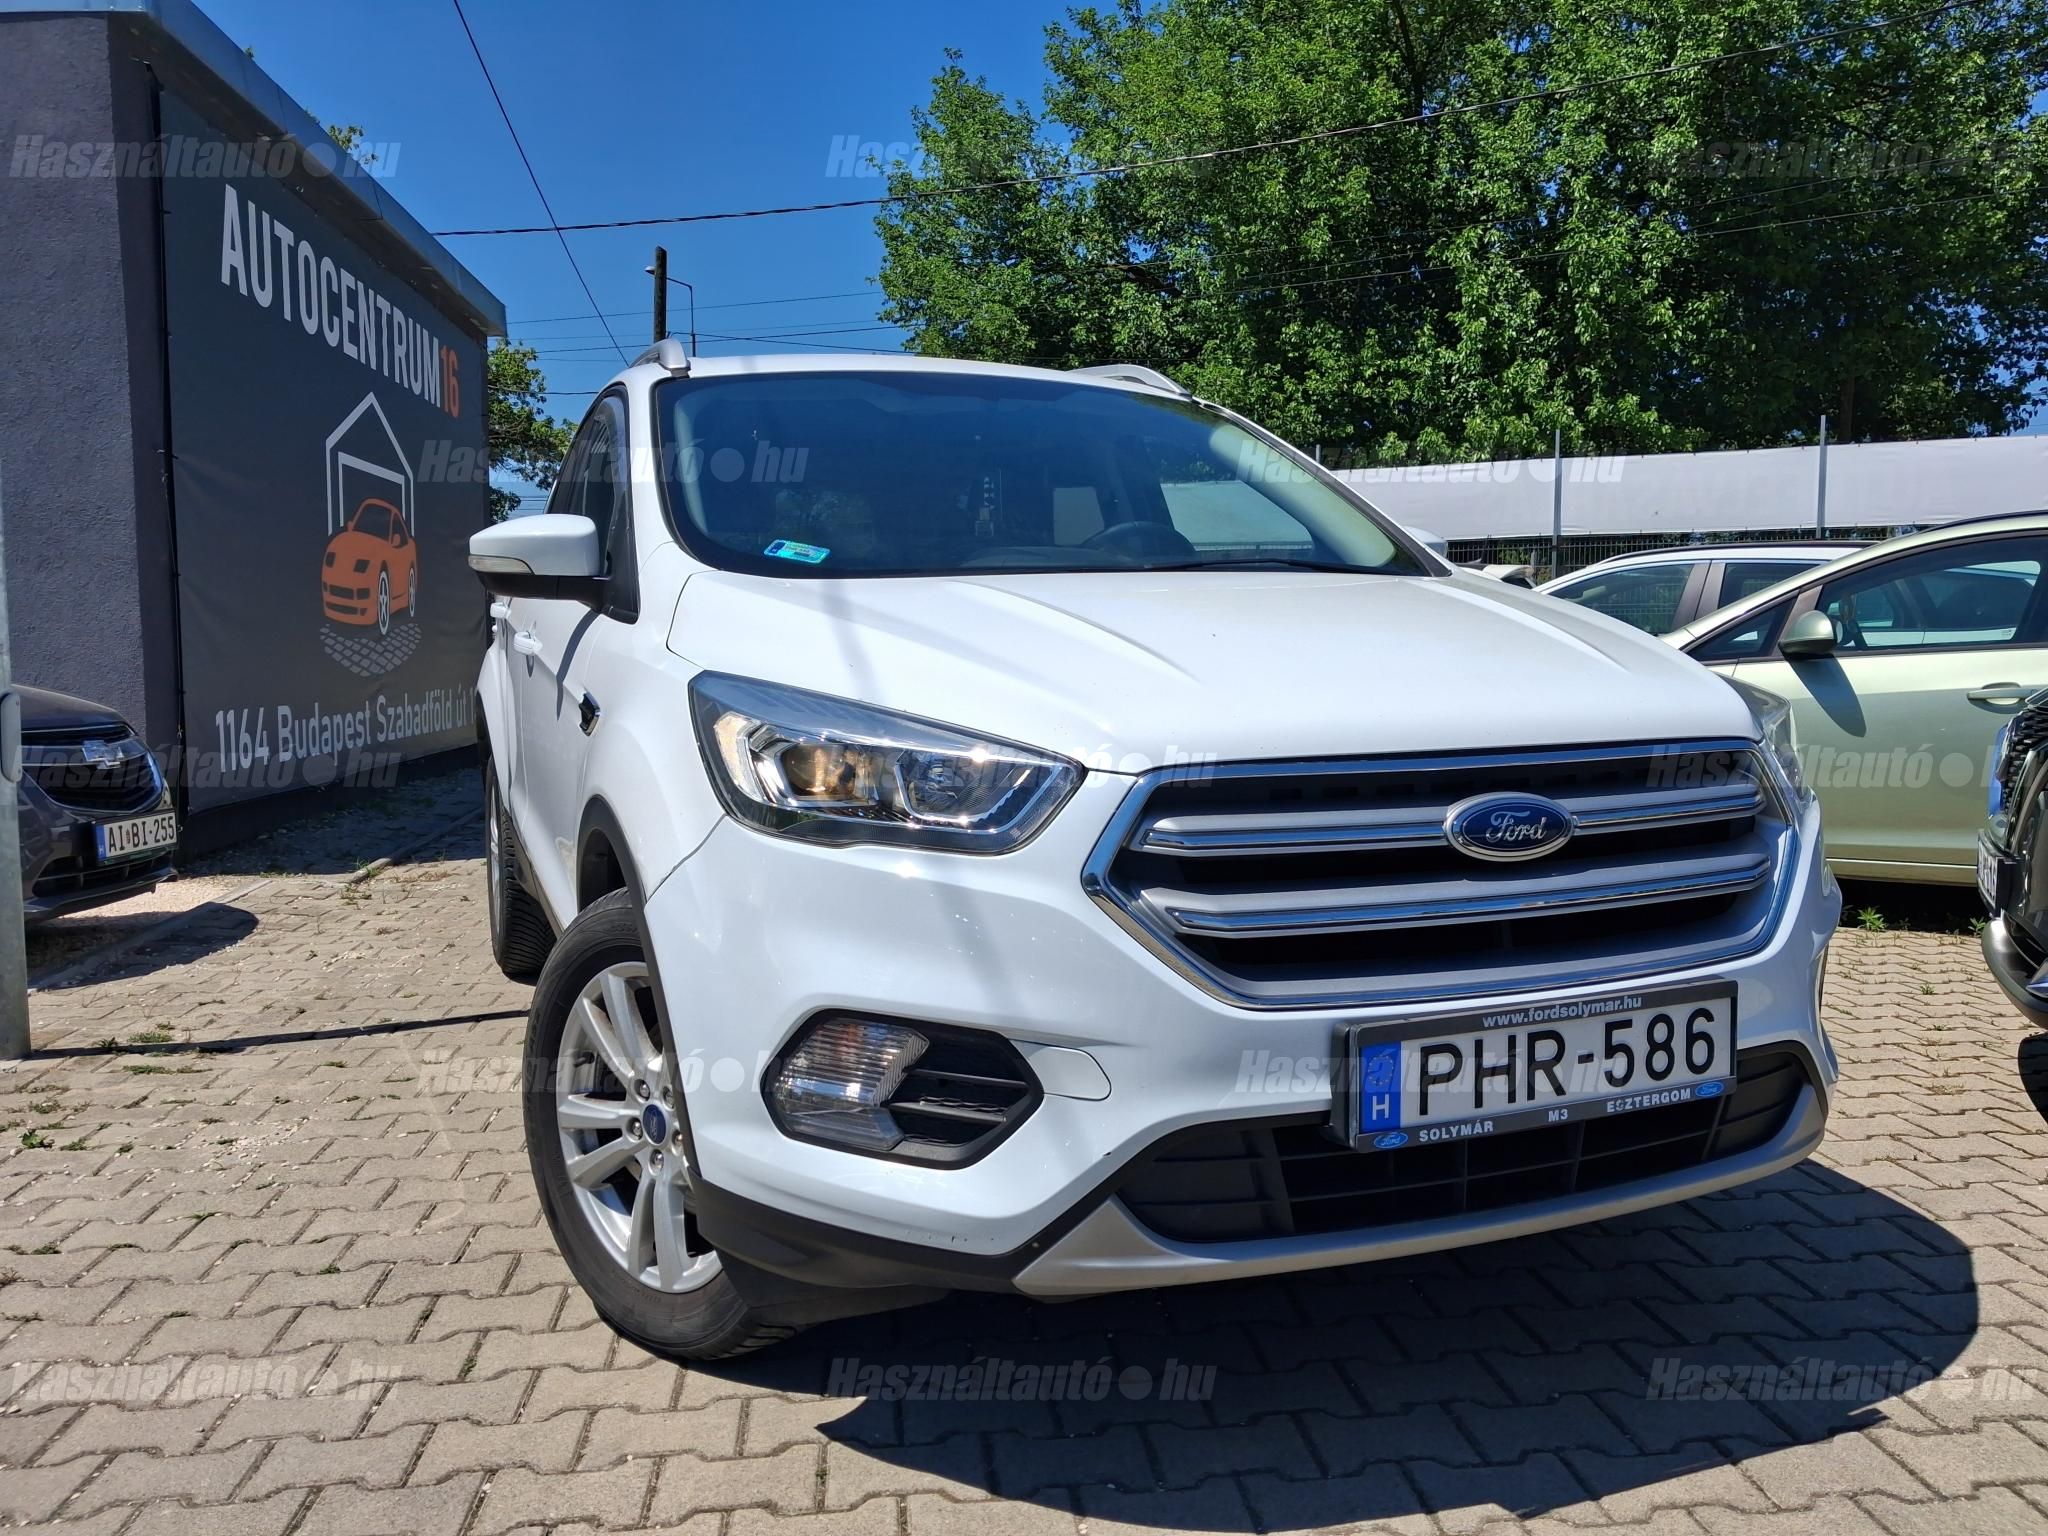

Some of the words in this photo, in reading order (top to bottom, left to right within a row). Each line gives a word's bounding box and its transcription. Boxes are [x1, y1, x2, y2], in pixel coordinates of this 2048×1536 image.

[215, 707, 270, 773] 1164
[277, 701, 372, 767] Budapest
[376, 688, 453, 743] Szabadföld
[109, 825, 125, 853] AI
[1486, 810, 1548, 843] Ford
[1483, 996, 1642, 1027] www.fordsolymar.hu
[1419, 1007, 1716, 1116] PHR-586
[1372, 1094, 1390, 1120] H
[1419, 1119, 1494, 1142] SOLYMÁR
[1548, 1108, 1568, 1122] M3
